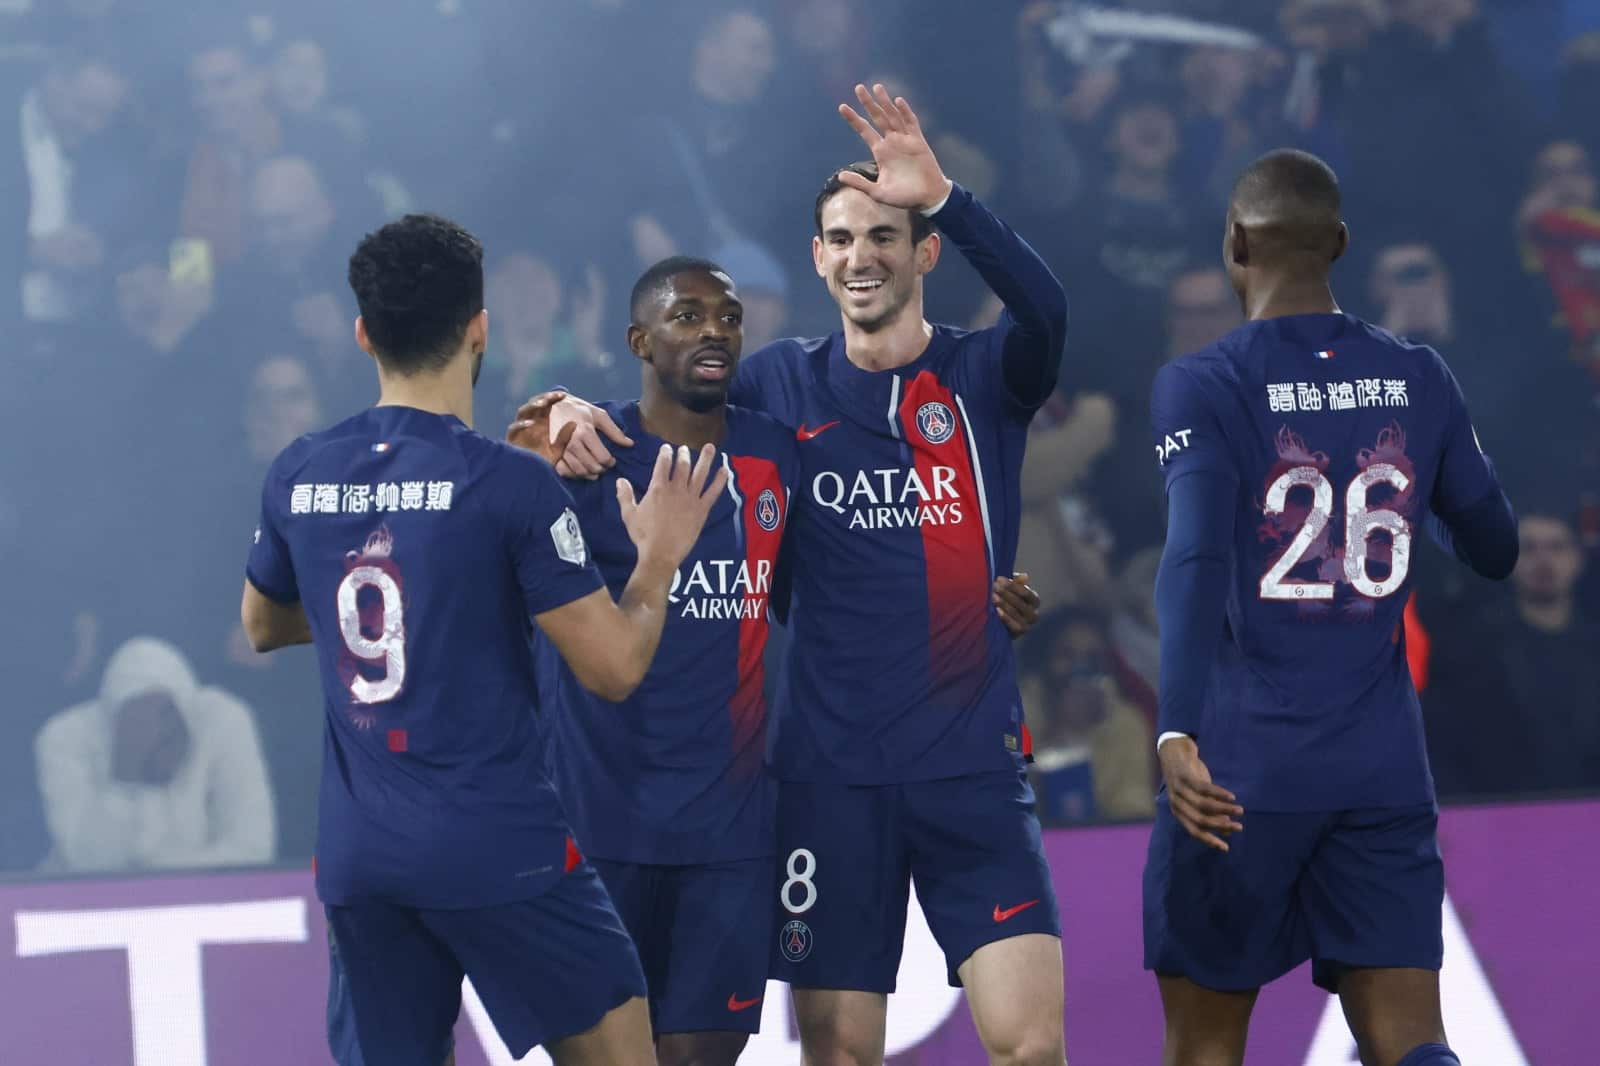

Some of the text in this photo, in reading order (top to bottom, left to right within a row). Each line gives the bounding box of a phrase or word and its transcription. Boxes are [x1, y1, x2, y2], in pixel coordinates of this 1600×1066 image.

[812, 465, 961, 514] QATAR
[849, 502, 963, 529] AIRWAYS
[1260, 463, 1412, 600] 26
[337, 565, 406, 705] 9
[681, 597, 764, 620] AIRWAY
[781, 848, 818, 914] 8
